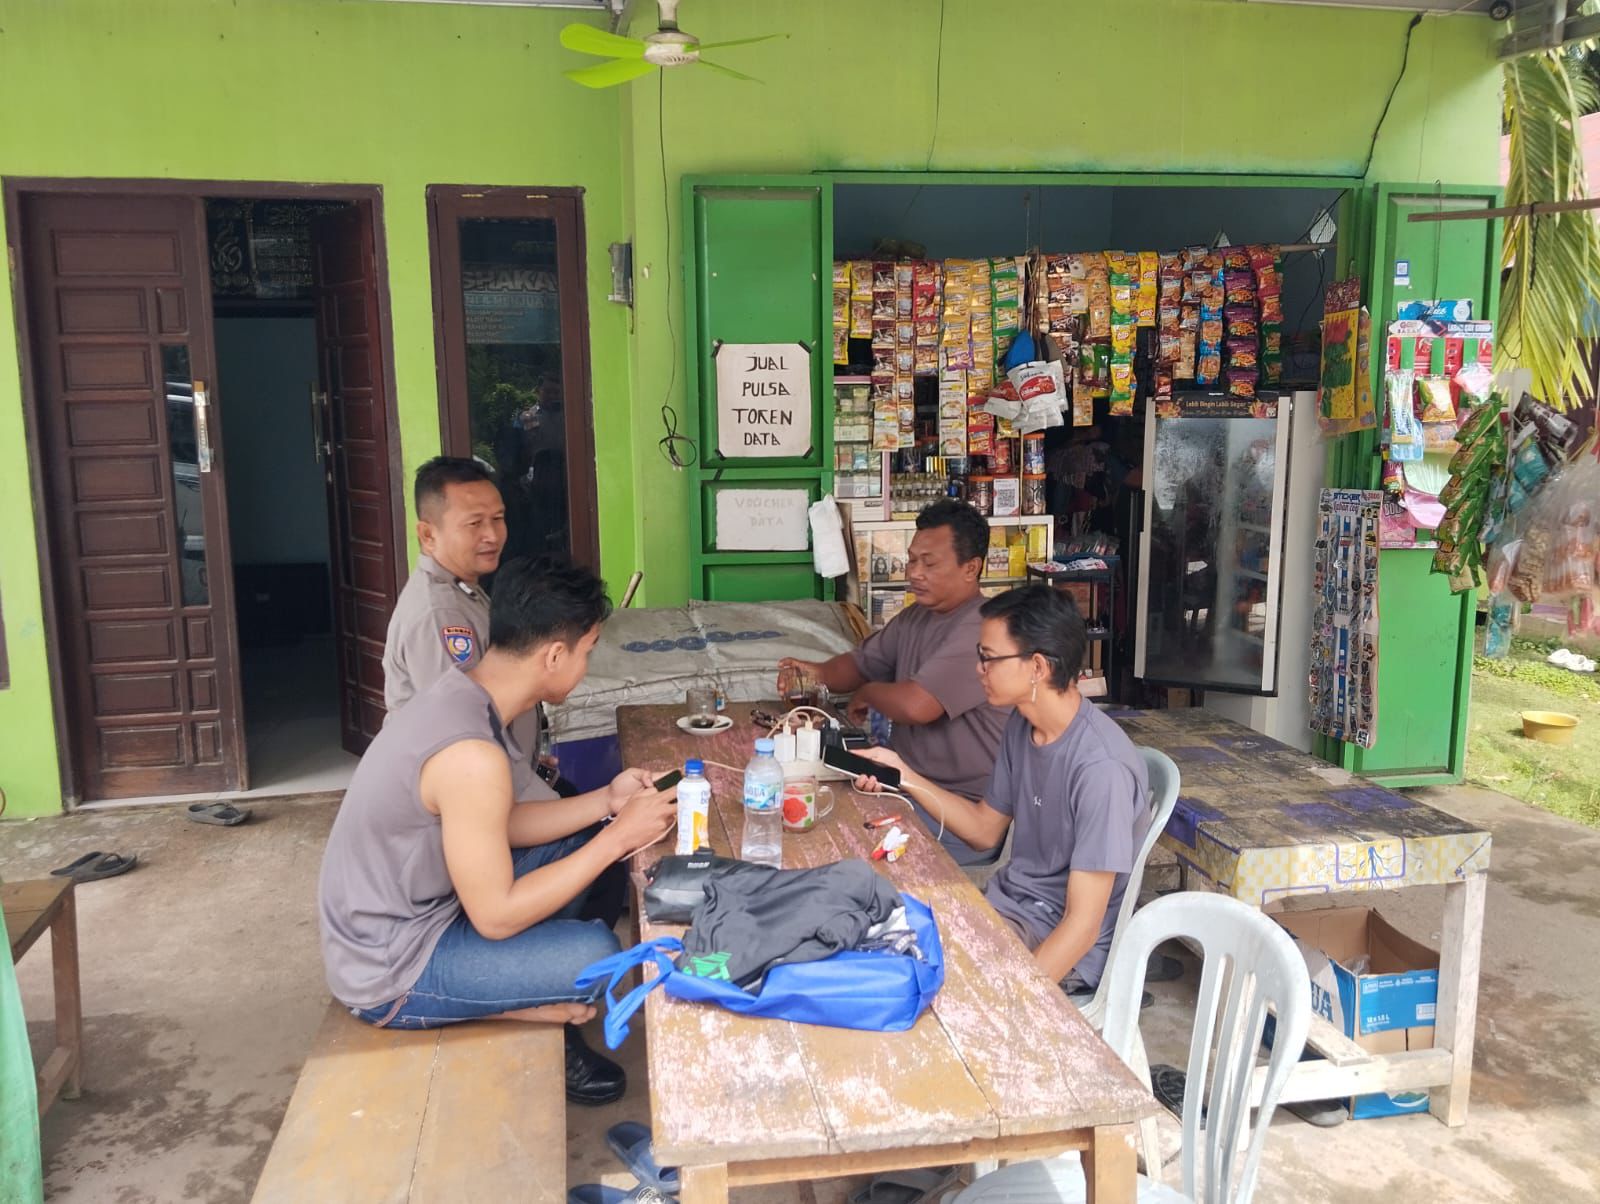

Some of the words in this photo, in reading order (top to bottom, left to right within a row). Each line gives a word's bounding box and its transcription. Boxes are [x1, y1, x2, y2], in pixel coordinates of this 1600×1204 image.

[745, 356, 789, 372] JUAL
[742, 381, 791, 397] PULSA
[731, 408, 793, 426] TOKEN
[744, 432, 781, 446] DATA
[751, 516, 784, 527] DATA
